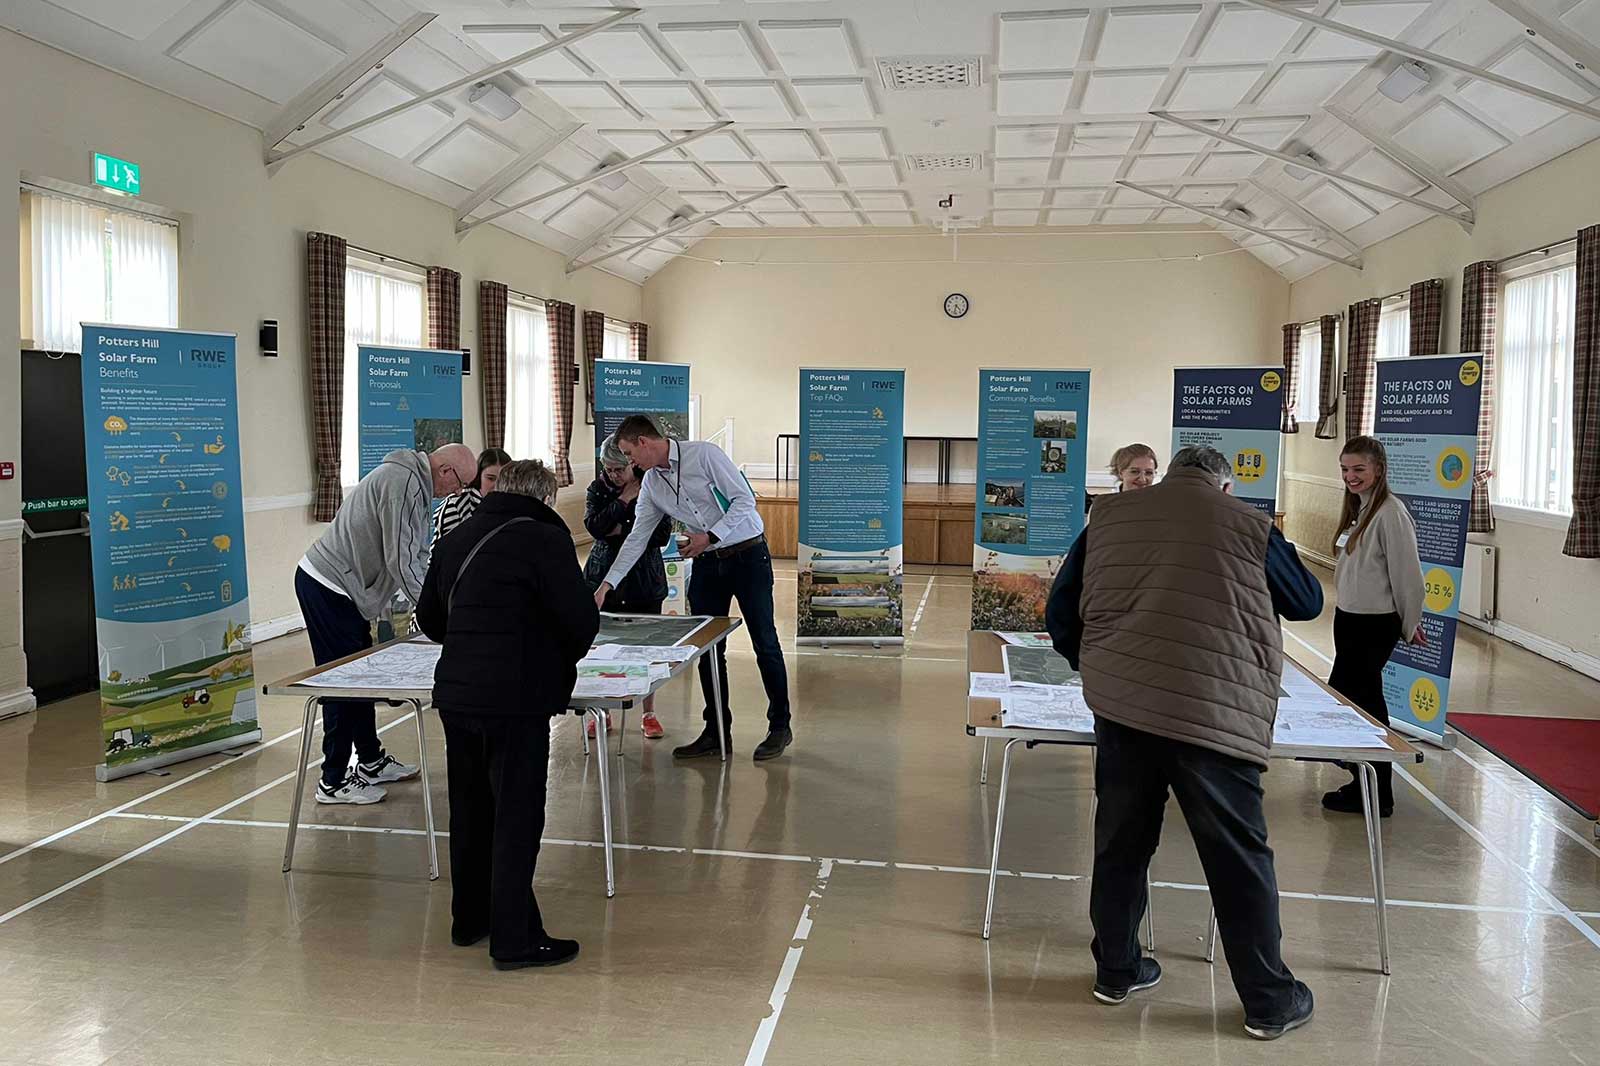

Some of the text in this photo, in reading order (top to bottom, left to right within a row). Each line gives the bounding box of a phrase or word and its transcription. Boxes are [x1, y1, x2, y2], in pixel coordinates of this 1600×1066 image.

[98, 336, 160, 348] Potters Hill
[99, 352, 157, 364] Solar Farm
[191, 349, 226, 363] RWE
[369, 354, 396, 364] Potters
[100, 366, 139, 378] Benefits
[369, 368, 387, 376] Solar
[434, 365, 456, 375] RWE
[369, 379, 401, 390] Proposals
[661, 376, 684, 385] RWE
[872, 381, 896, 389] RWE
[1183, 386, 1254, 394] THE FACTS ON
[1384, 380, 1452, 392] THE FACTS ON
[629, 389, 649, 398] Capital
[989, 394, 1028, 403] Community
[1182, 396, 1252, 406] SOLAR FARMS
[1383, 393, 1449, 405] SOLAR FARMS
[28, 501, 46, 510] Push
[1443, 586, 1452, 598] %
